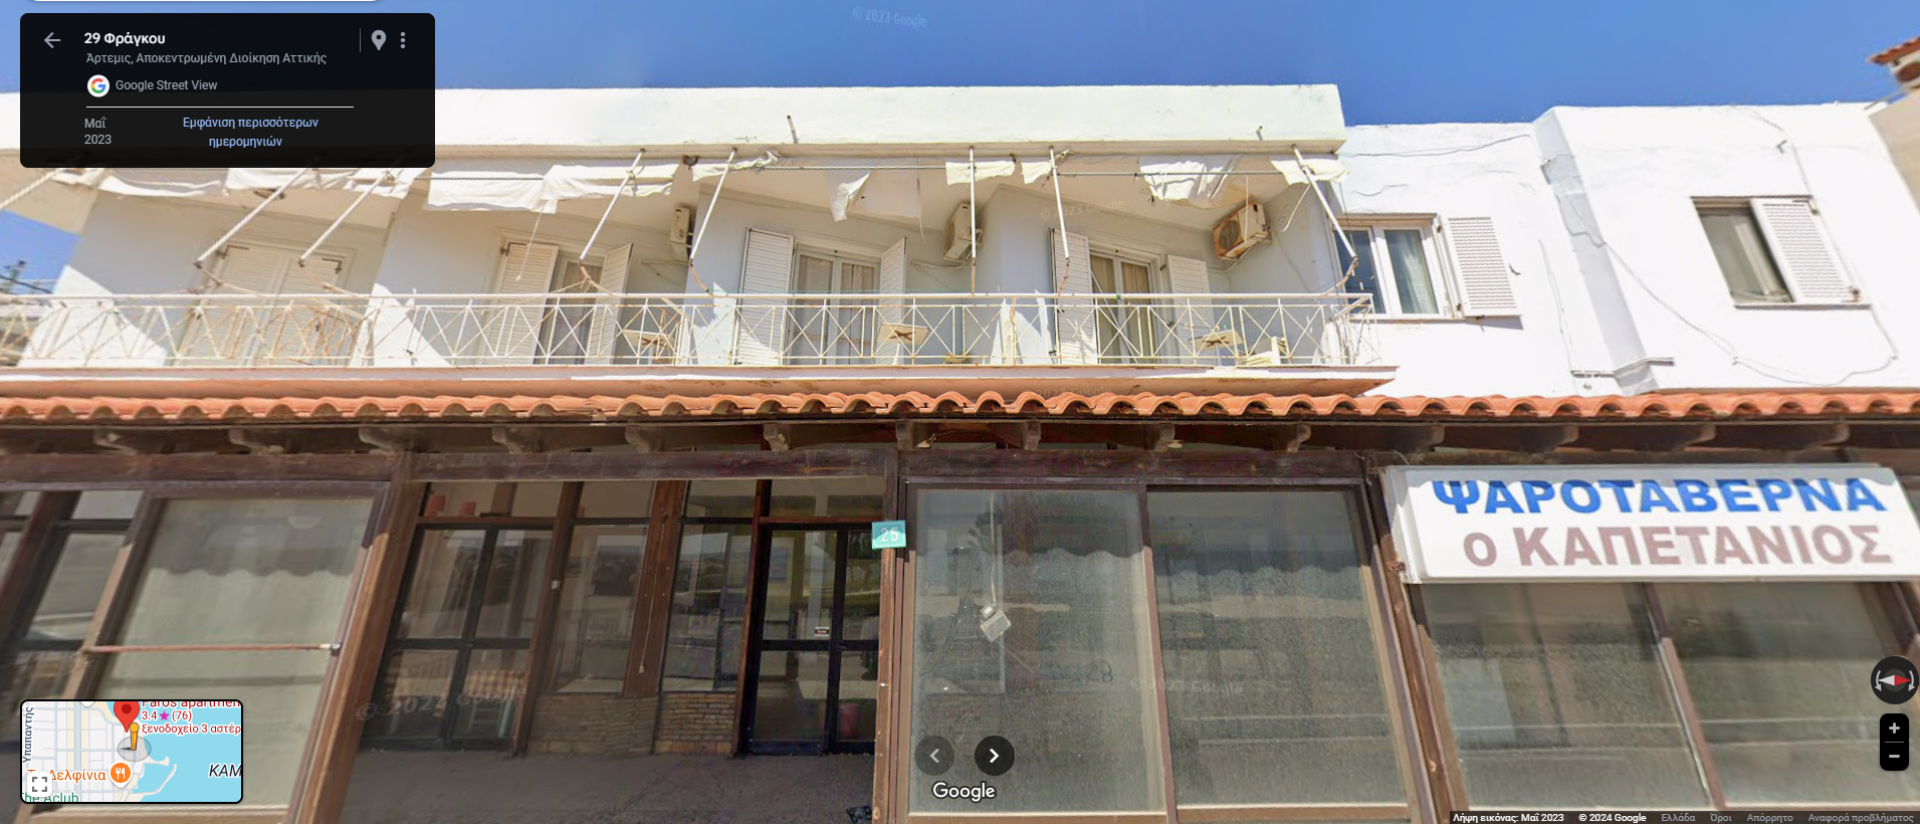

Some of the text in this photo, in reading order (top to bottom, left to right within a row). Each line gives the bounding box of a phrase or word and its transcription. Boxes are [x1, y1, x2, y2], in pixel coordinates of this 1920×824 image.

[1431, 478, 1887, 514] ΨΑΡΟΤΑΒΕΡΝΑ
[880, 526, 900, 543] 25
[1512, 525, 1892, 567] ΚΑΠΕΤΑΝΙΟΣ
